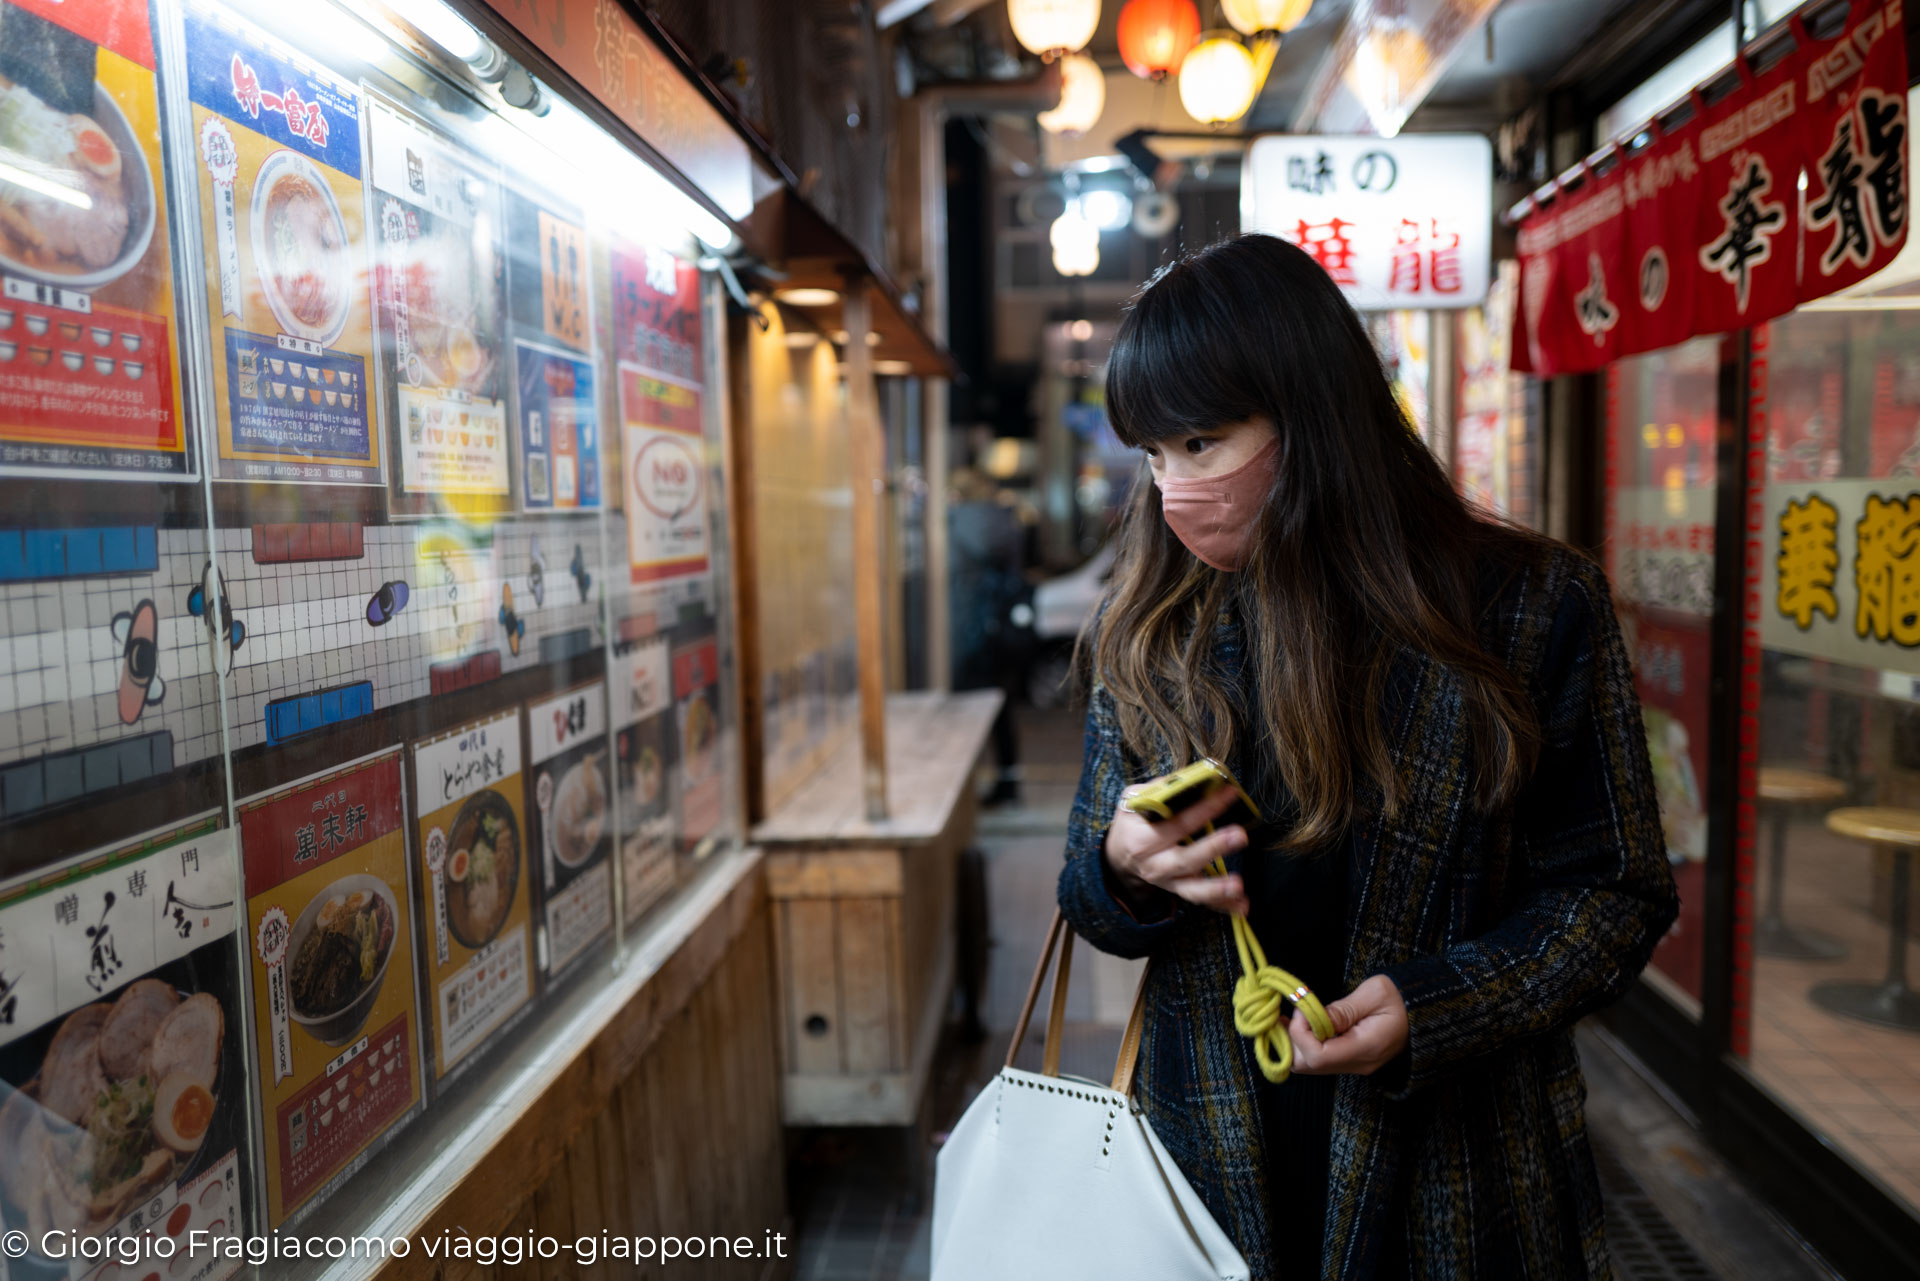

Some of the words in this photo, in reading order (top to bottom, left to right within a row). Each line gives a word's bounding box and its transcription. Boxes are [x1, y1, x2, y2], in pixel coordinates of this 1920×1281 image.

[1286, 145, 1397, 194] 味の
[294, 804, 368, 864] 萬来軒
